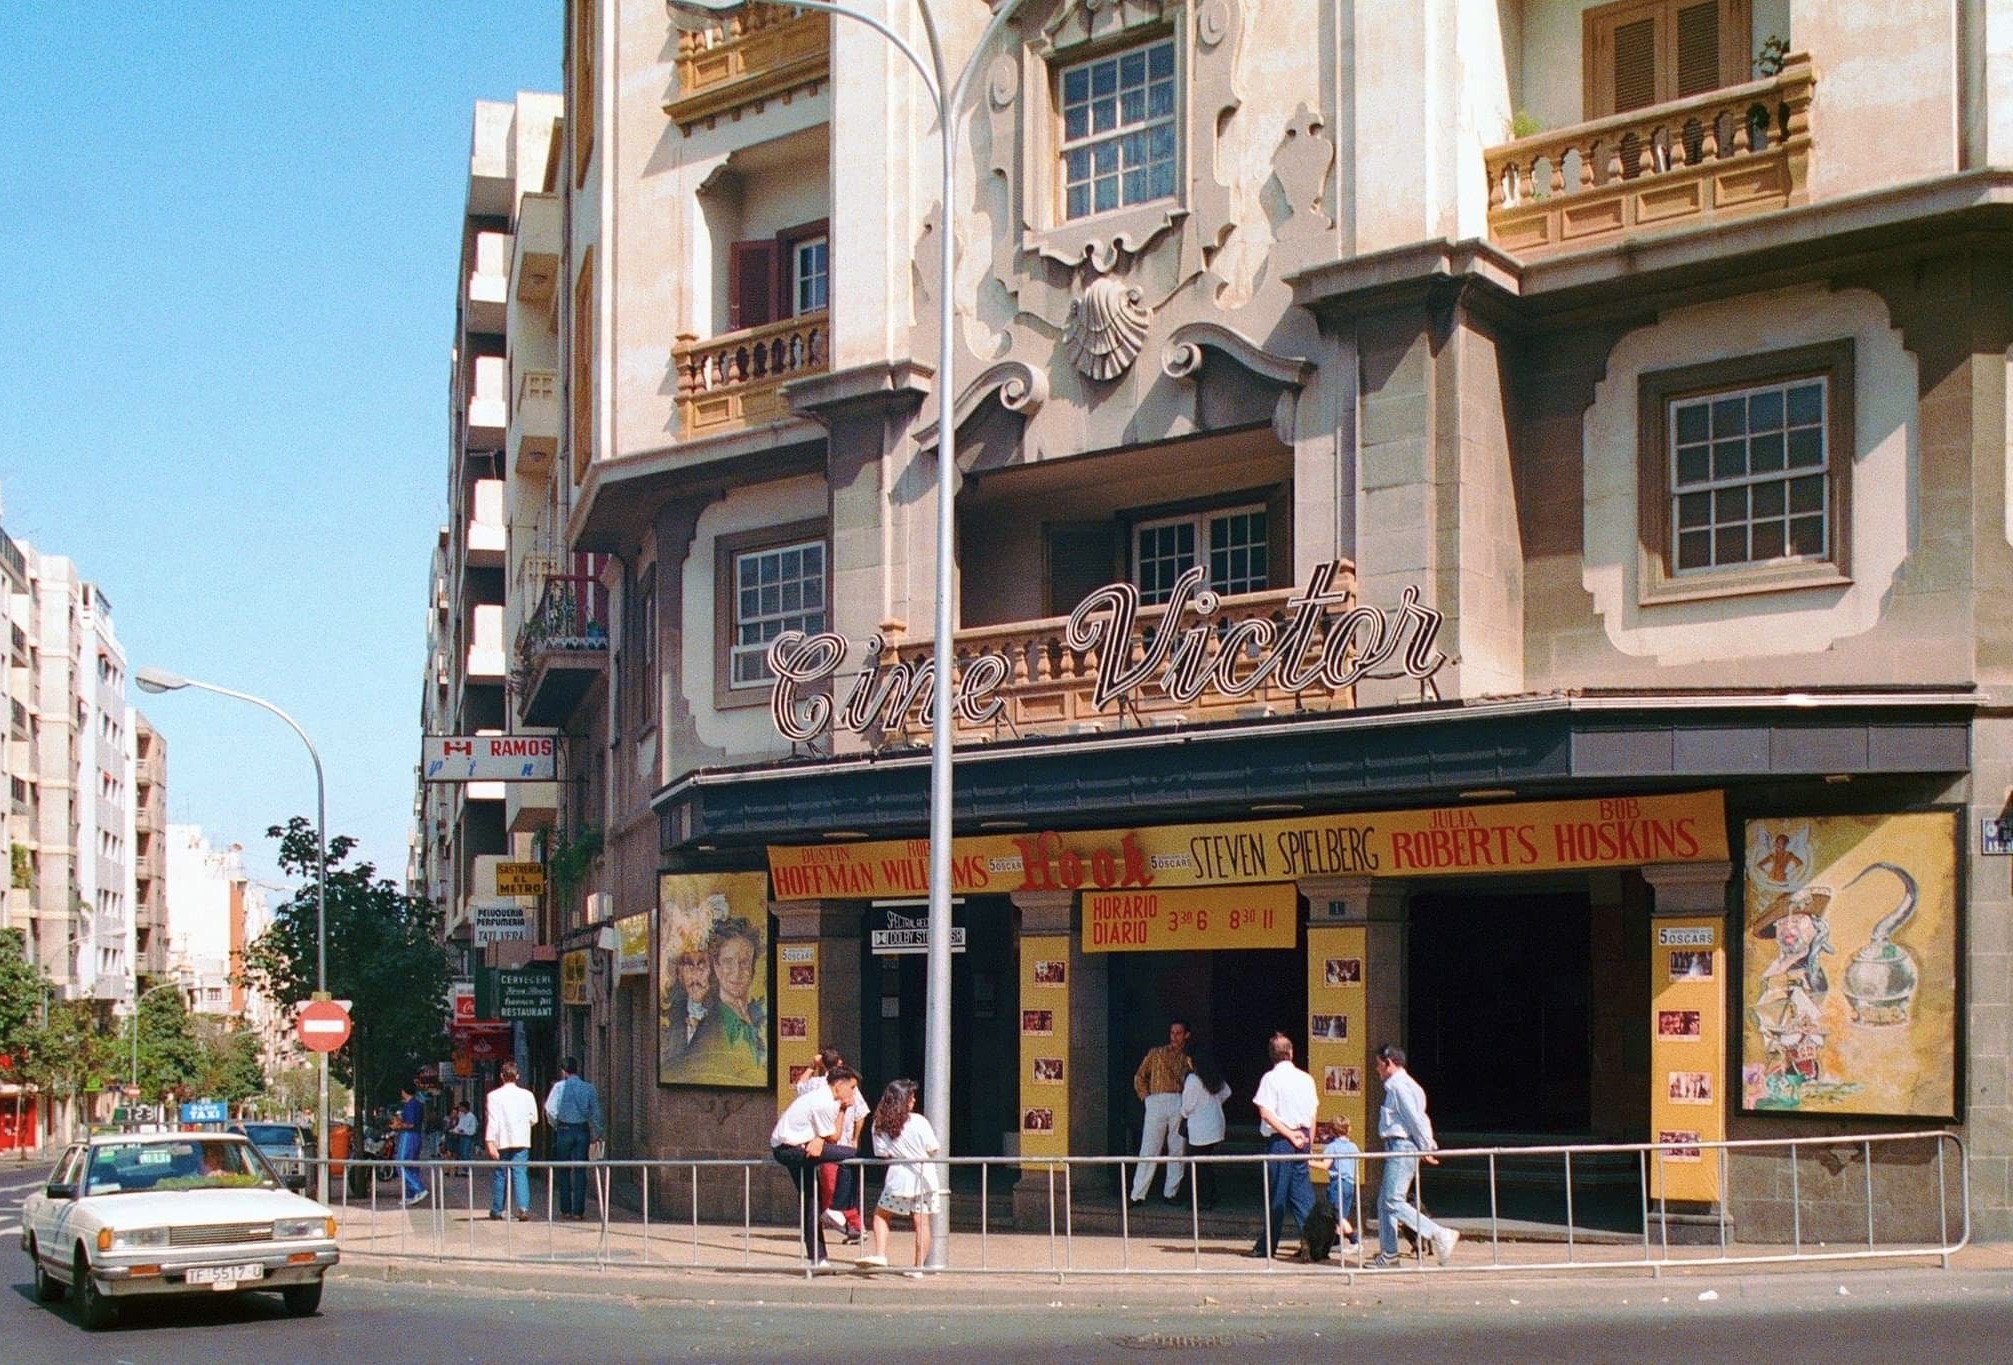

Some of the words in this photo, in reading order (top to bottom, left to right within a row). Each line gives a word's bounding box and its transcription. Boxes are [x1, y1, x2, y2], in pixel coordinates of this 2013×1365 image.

[768, 630, 1010, 742] Cine
[1066, 559, 1447, 712] Victor
[490, 740, 552, 756] RAMOS
[1600, 799, 1641, 820] BOB
[1429, 810, 1478, 829] JULIA
[907, 840, 930, 858] ROB
[1189, 832, 1267, 879] STEVEN
[1277, 826, 1380, 875] SPIELBERG
[1391, 824, 1539, 870] ROBERTS
[1554, 817, 1700, 863] HOSKINS
[802, 846, 852, 864] DUSTIN
[1011, 830, 1156, 891] Hook
[1151, 856, 1158, 869] 5
[989, 859, 996, 872] 5
[996, 861, 1022, 871] OSCAR
[774, 861, 875, 897] HOFFMAN
[880, 855, 990, 891] WILLMS
[500, 884, 541, 893] METRO
[1093, 894, 1158, 921] HORARIO
[1196, 910, 1208, 931] 6
[1263, 908, 1274, 929] 11
[890, 931, 914, 944] DOLBY
[1093, 920, 1148, 945] DIARIO
[1660, 929, 1668, 944] 5
[1669, 934, 1713, 944] OSCARS
[501, 975, 552, 985] CERVECERI
[501, 1007, 552, 1017] RESTAURANT
[189, 1109, 220, 1119] TAXI
